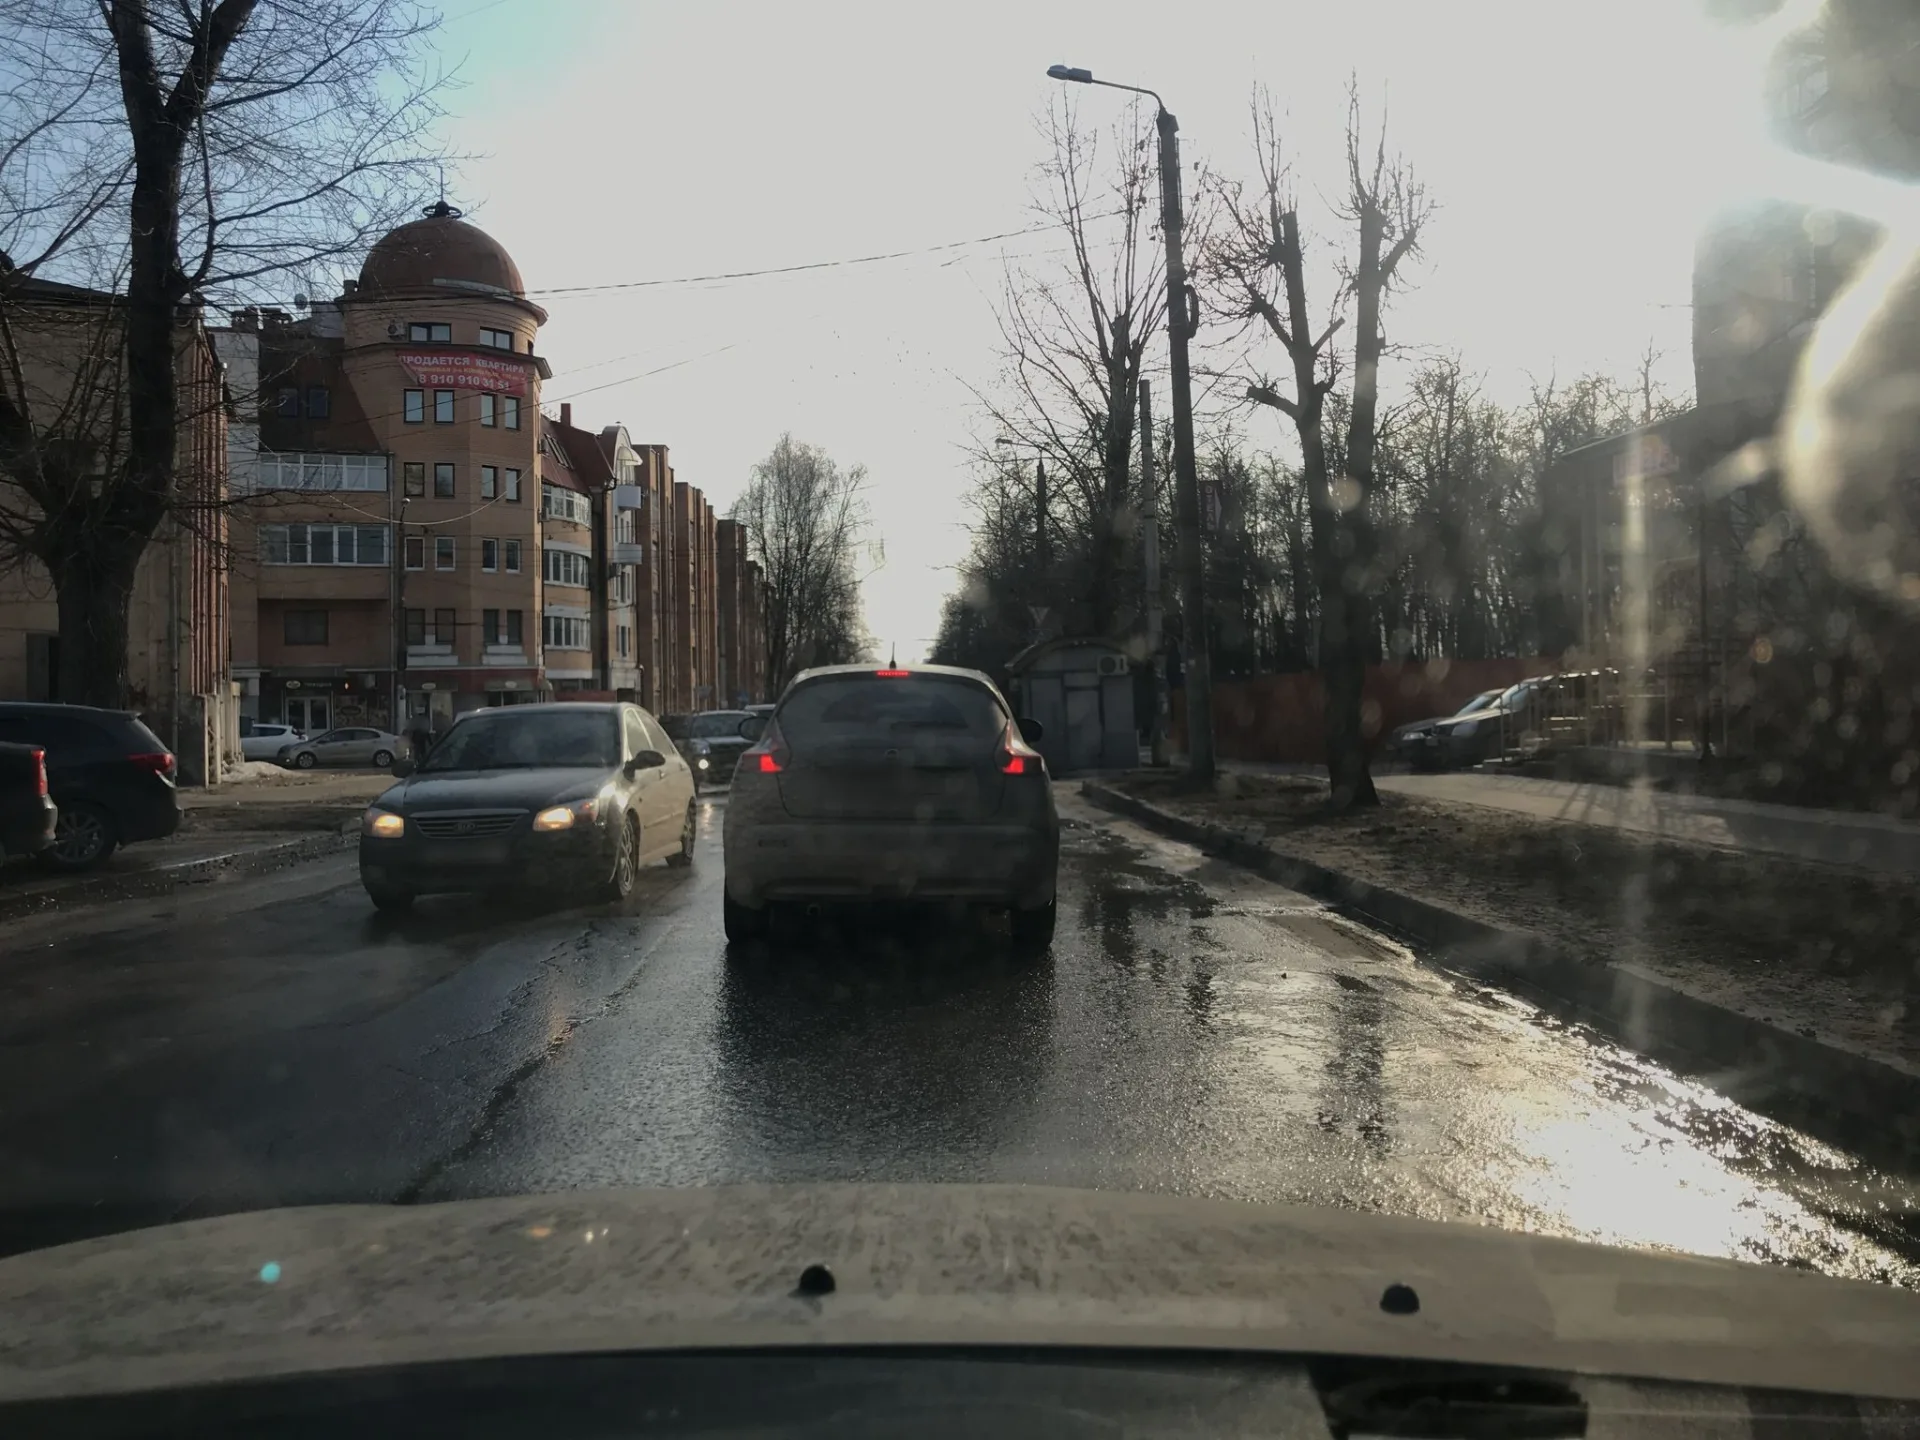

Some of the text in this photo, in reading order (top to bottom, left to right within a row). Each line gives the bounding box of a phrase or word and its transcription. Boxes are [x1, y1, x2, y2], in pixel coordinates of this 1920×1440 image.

[399, 355, 470, 366] ПРОДАЕТСЯ
[476, 358, 525, 373] КВАРТИРА
[419, 373, 427, 384] 8
[430, 374, 455, 384] 910
[458, 375, 480, 385] 910
[482, 378, 494, 388] 31
